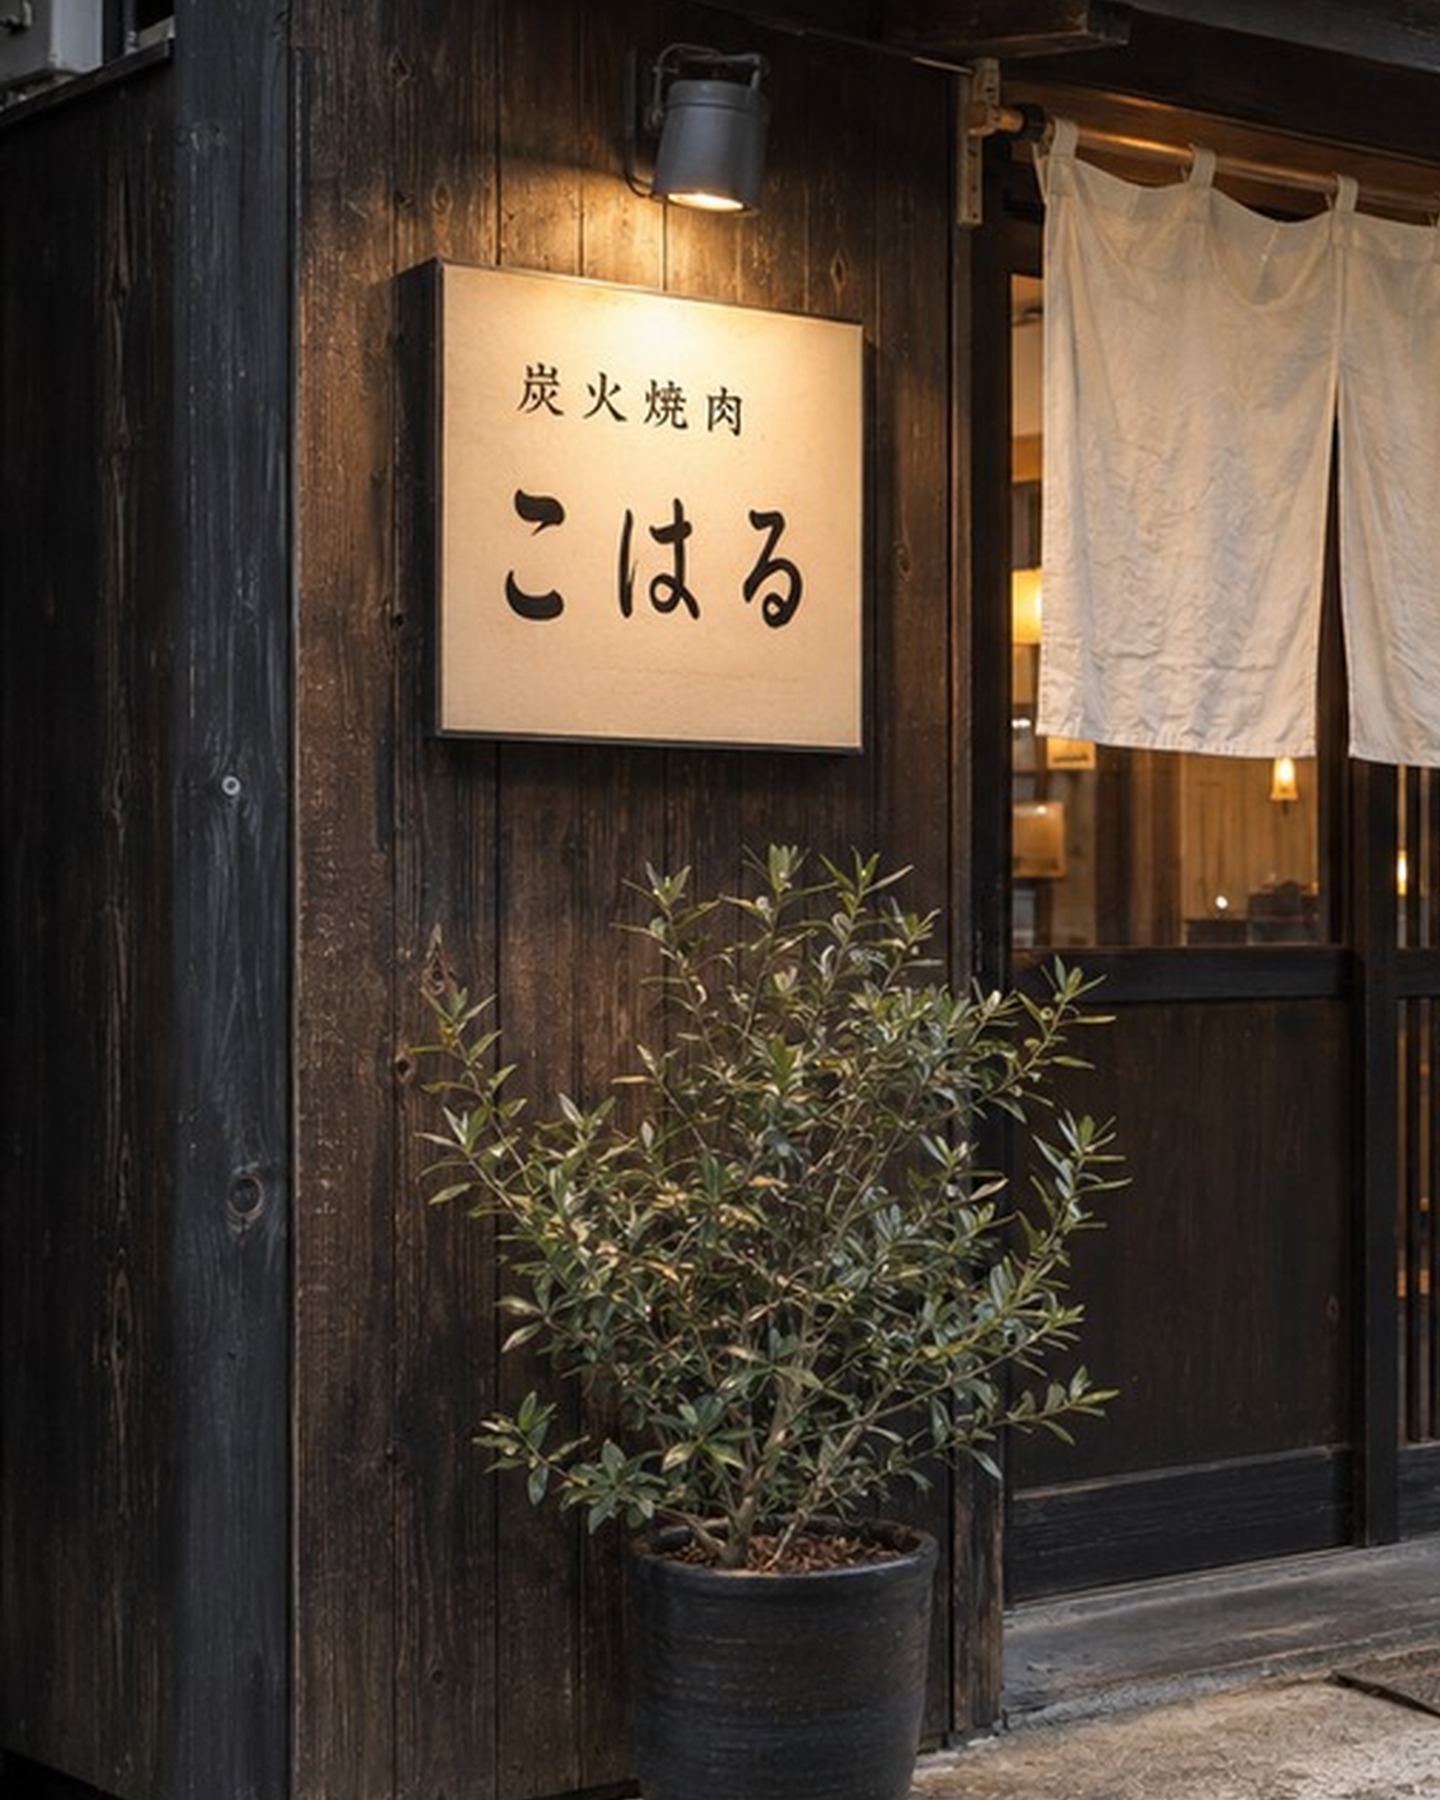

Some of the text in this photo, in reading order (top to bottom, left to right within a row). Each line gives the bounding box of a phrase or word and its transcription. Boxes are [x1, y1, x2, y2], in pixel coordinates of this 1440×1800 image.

[516, 361, 744, 437] 炭火焼肉
[503, 488, 803, 630] こはる
